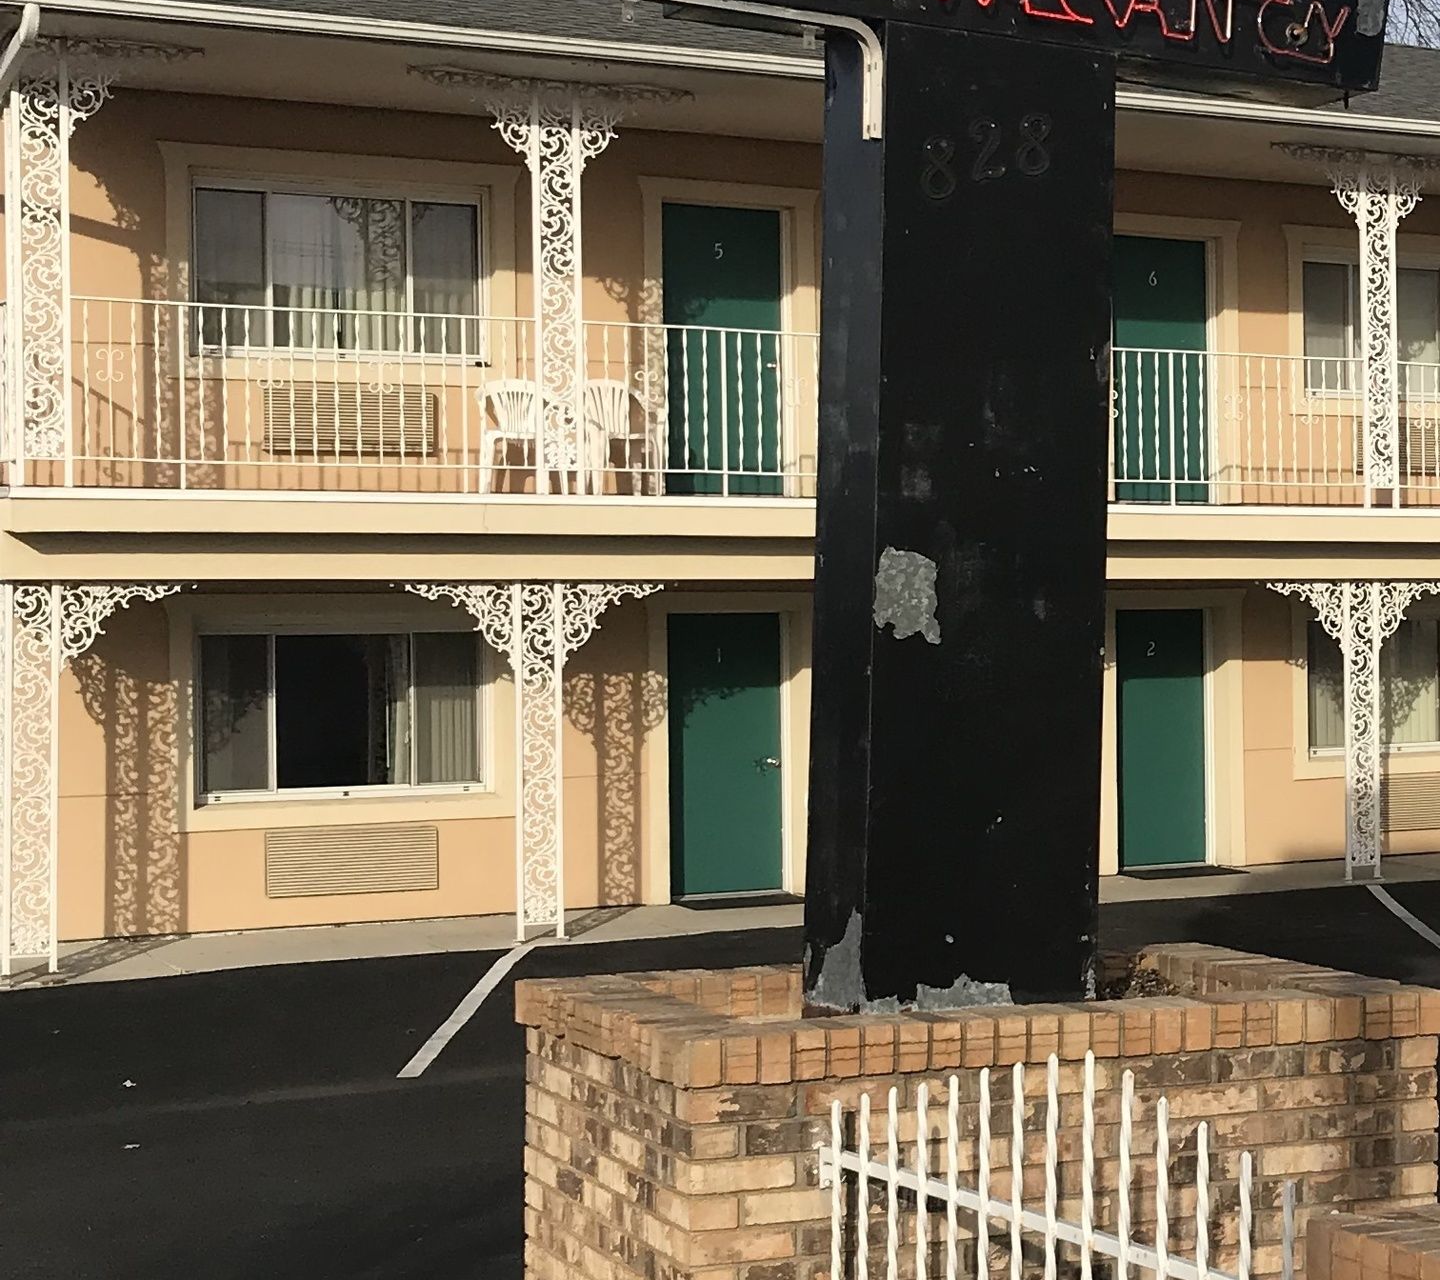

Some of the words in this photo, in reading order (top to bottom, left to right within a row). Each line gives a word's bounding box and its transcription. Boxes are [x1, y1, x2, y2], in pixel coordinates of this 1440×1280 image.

[921, 113, 1051, 200] 828
[714, 242, 724, 260] 5
[1148, 270, 1158, 287] 6
[1146, 641, 1156, 657] 2
